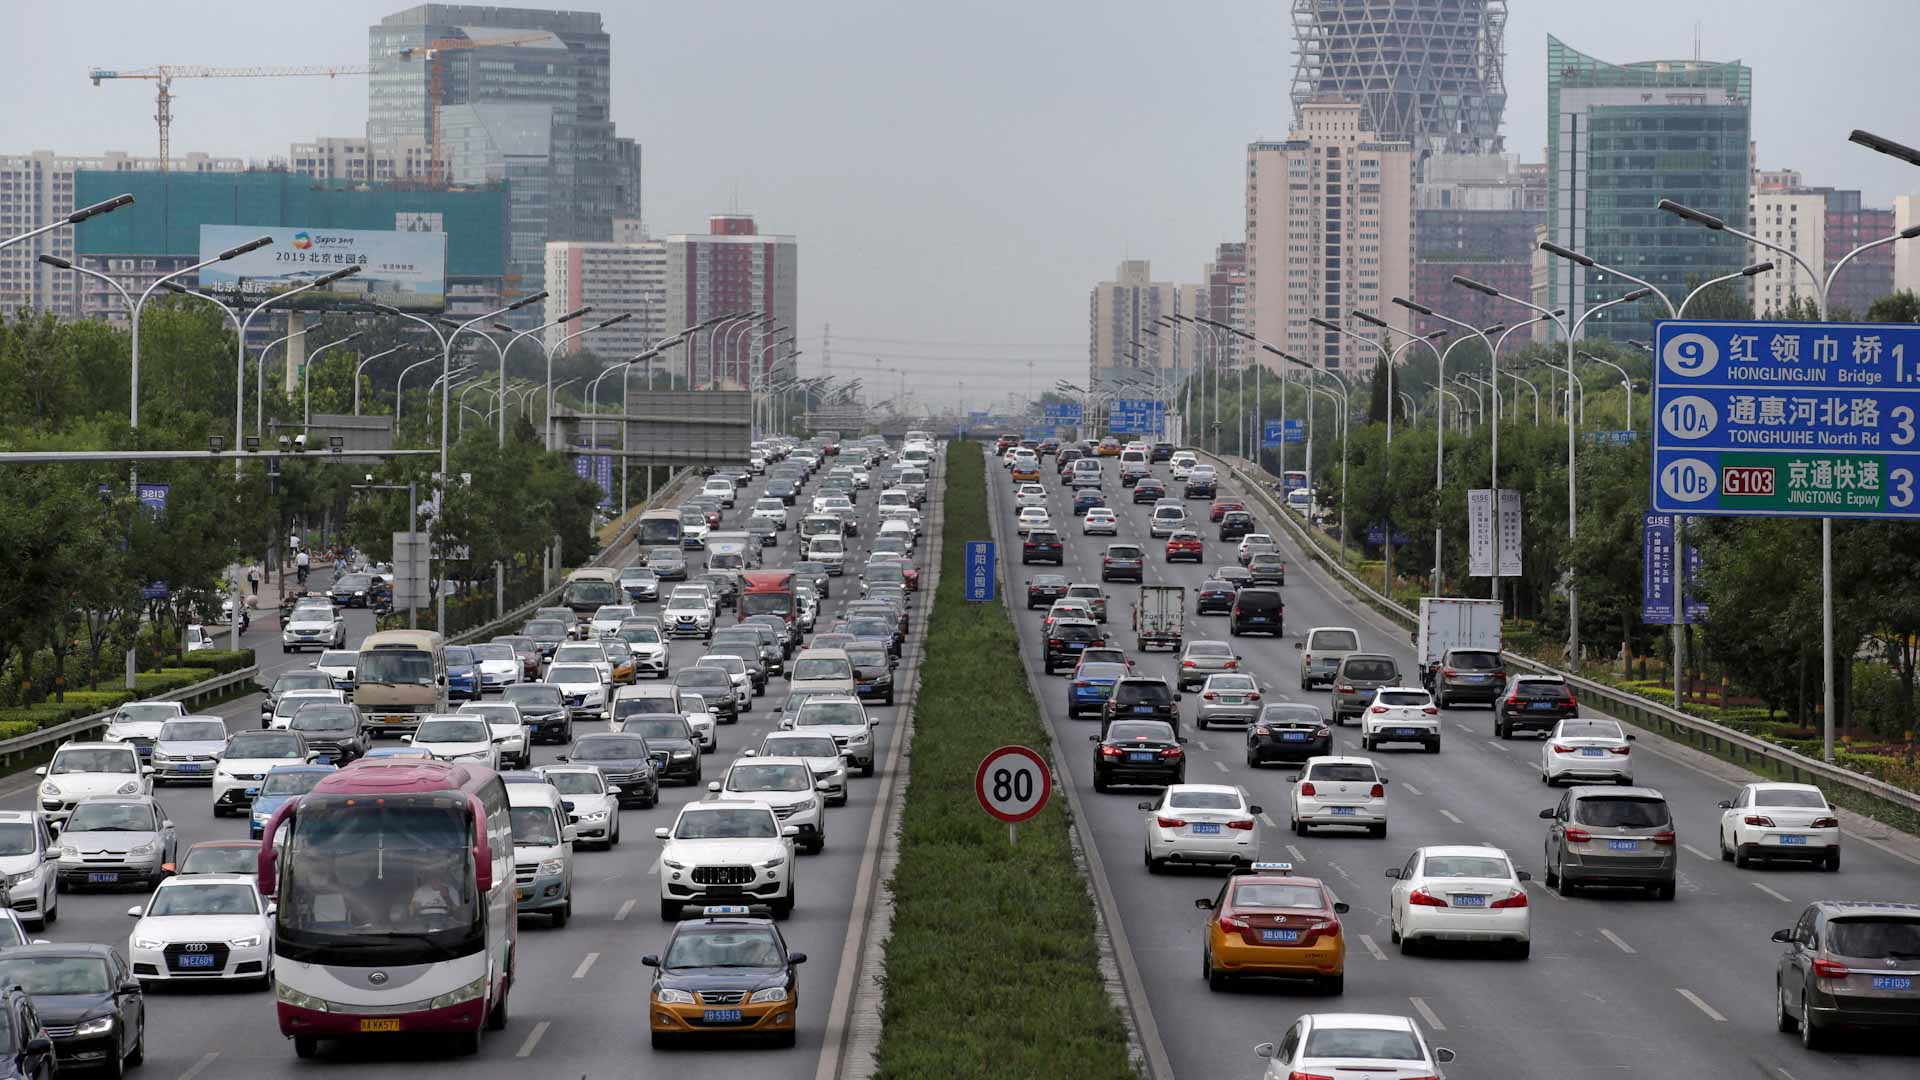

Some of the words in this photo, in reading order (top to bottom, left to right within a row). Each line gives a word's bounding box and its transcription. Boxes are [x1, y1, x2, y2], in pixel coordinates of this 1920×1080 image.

[1677, 341, 1705, 370] 9
[1729, 333, 1883, 365] 红领巾桥
[1728, 367, 1826, 382] HONGLINGJIN
[1838, 369, 1882, 384] Bridge
[1670, 403, 1708, 432] 10A
[1727, 395, 1880, 428] 通惠河北路
[1890, 405, 1915, 446] 3
[1728, 430, 1813, 445] TONGHUIHE
[1818, 431, 1857, 446] North
[1861, 432, 1880, 446] Rd
[1670, 465, 1708, 494] 10B
[1725, 470, 1773, 492] G103
[1788, 459, 1880, 490] 京通快速
[1889, 468, 1914, 508] 3
[1788, 491, 1842, 505] JINGTONG
[1847, 493, 1880, 507] Expwy
[1647, 516, 1670, 525] CISE
[993, 768, 1033, 802] 80
